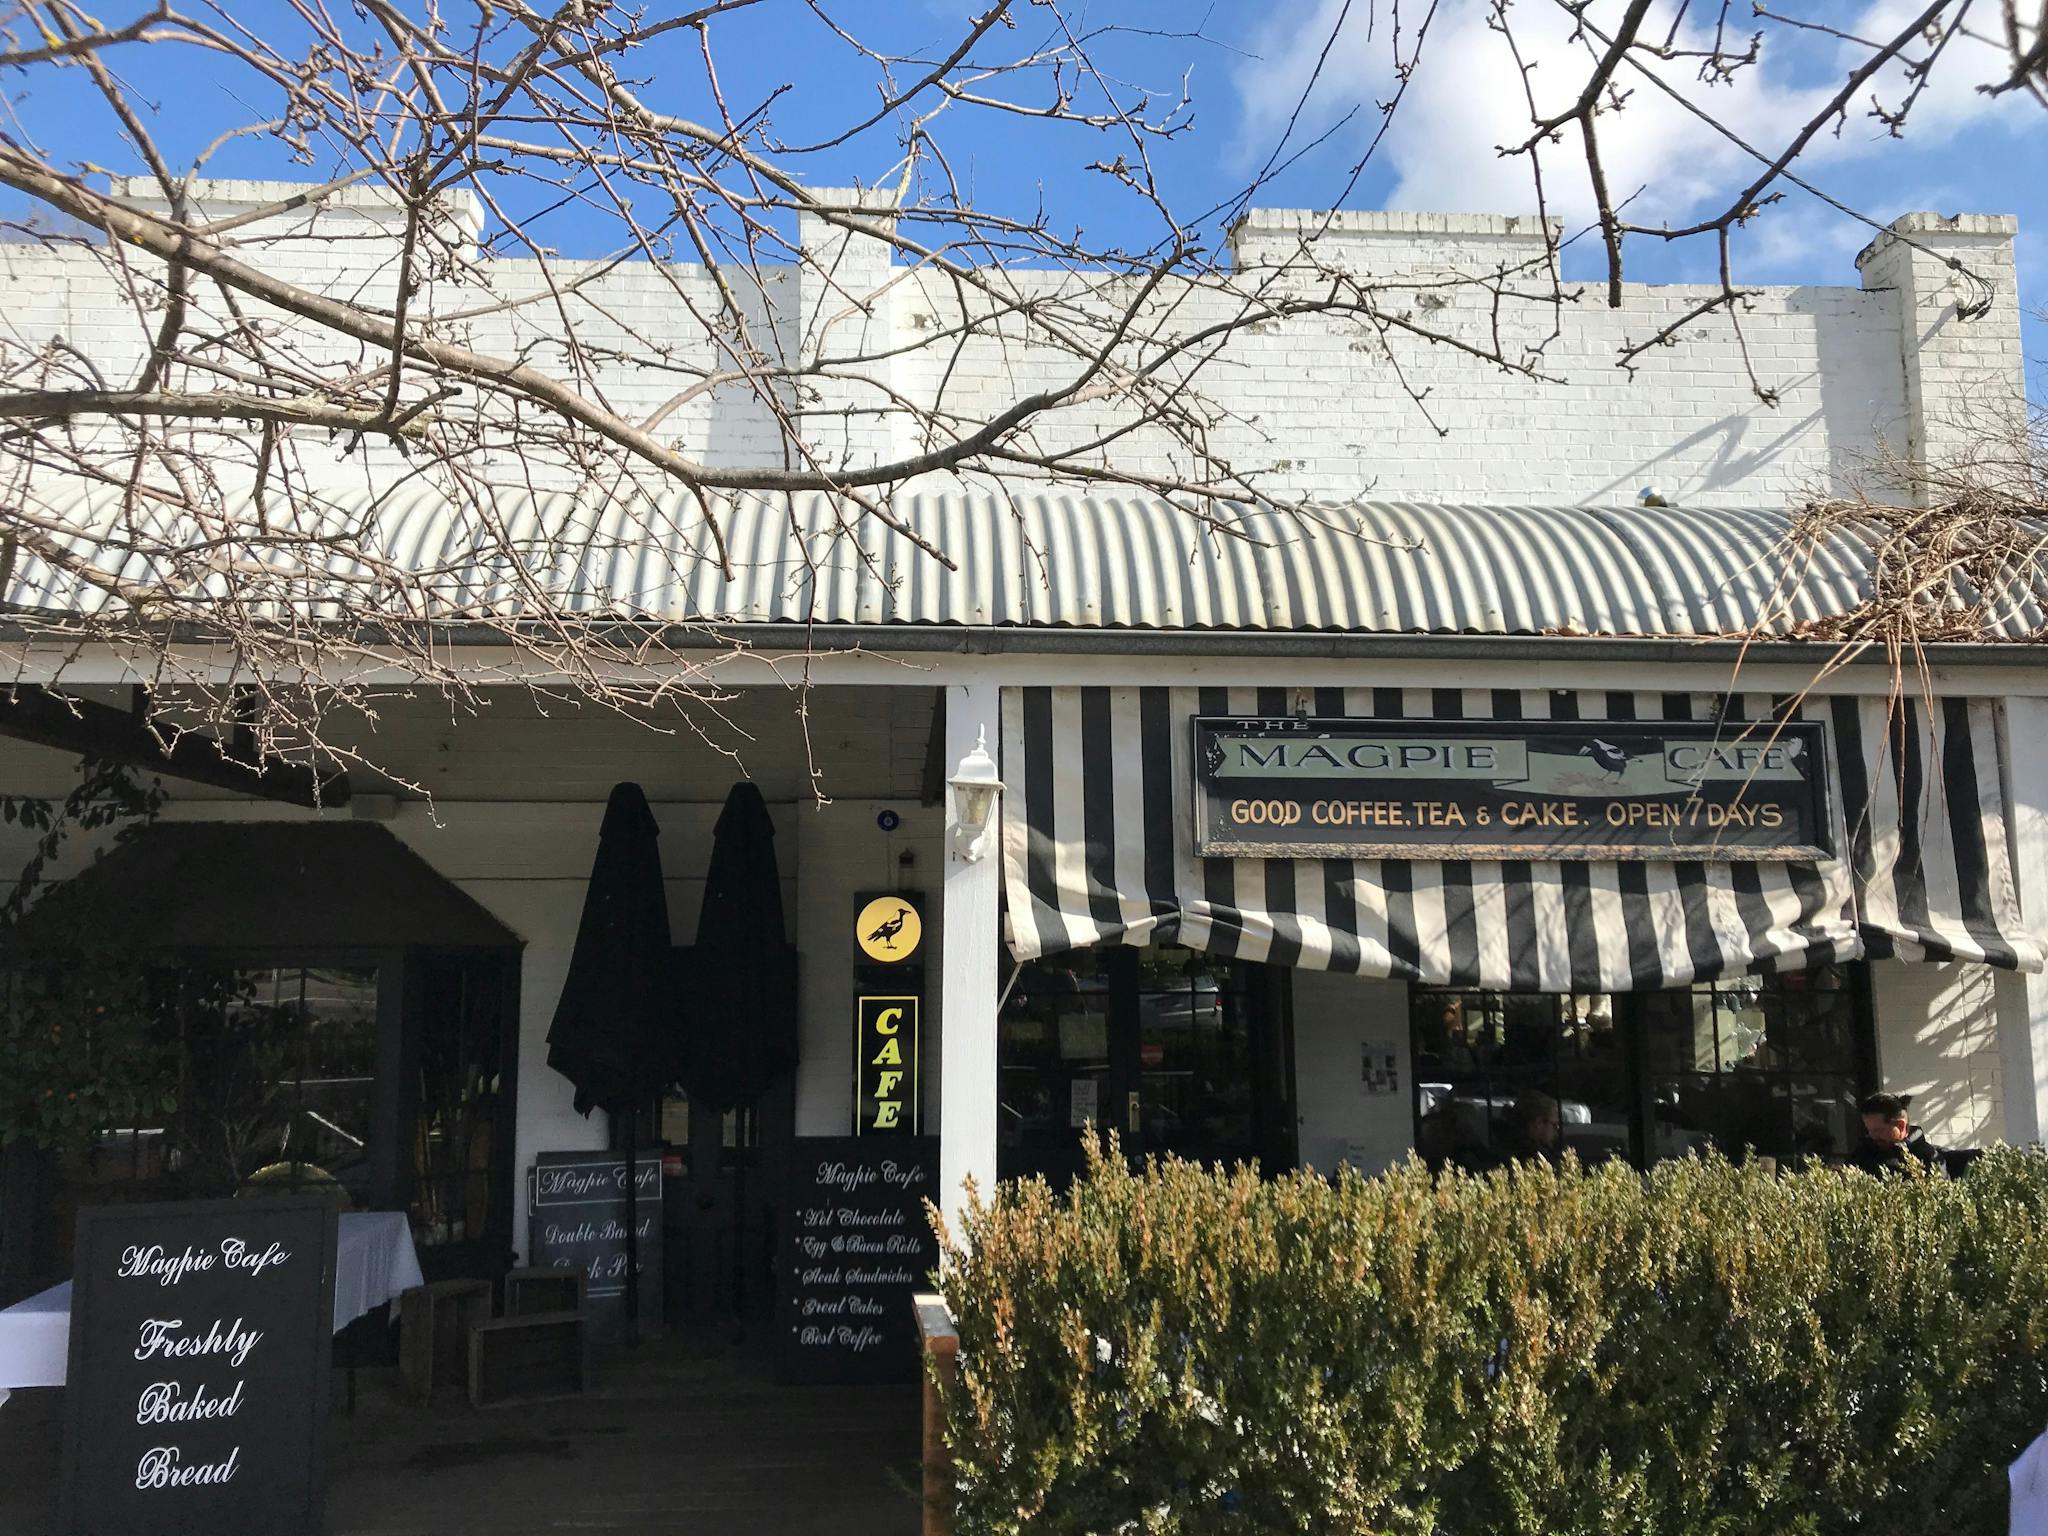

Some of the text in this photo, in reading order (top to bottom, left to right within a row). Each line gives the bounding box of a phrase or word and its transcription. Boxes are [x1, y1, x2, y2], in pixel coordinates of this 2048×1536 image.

[1236, 720, 1310, 730] THE
[1238, 743, 1787, 771] MAGPIE CAFE
[1230, 799, 1303, 827] GOOD
[1475, 805, 1492, 826] &
[1500, 801, 1590, 827] CAKE.
[1606, 801, 1681, 828] OPEN
[1686, 797, 1704, 827] 7
[1707, 802, 1784, 828] DAYS
[871, 1007, 904, 1129] CAFE
[539, 1170, 609, 1195] Magpie
[816, 1159, 927, 1192] Magpie Cafe
[803, 1207, 905, 1227] Hot Chocolate
[544, 1222, 596, 1245] Double
[802, 1236, 827, 1259] Egg
[845, 1234, 884, 1254] Bacon
[885, 1233, 922, 1255] Rolls
[117, 1237, 292, 1287] Magpie Cafe
[802, 1265, 913, 1287] Steak Sandwiches
[801, 1294, 884, 1317] Great Cakes
[133, 1317, 264, 1368] Freshly
[800, 1324, 883, 1353] Best Coffee
[136, 1380, 245, 1425] Baked
[135, 1446, 241, 1490] Bread
